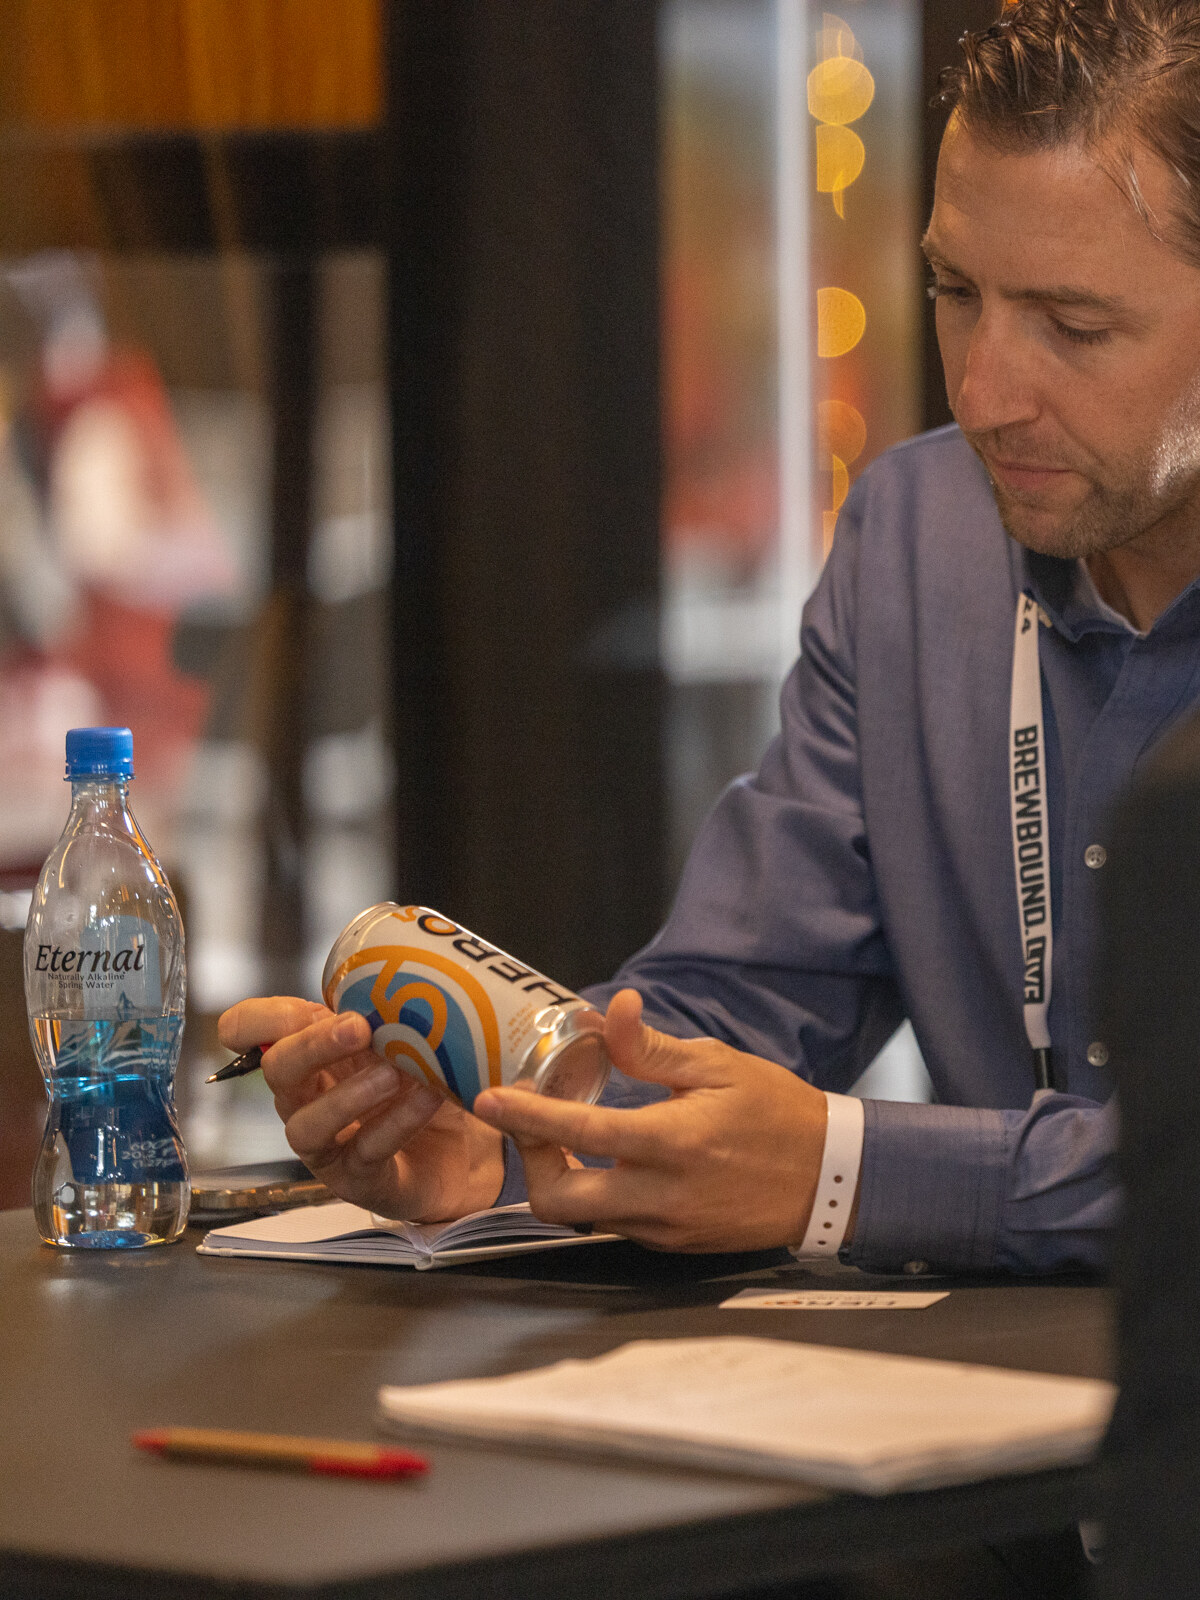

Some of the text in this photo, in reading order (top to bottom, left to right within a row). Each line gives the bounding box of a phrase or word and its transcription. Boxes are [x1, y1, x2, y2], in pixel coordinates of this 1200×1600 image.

[35, 943, 145, 973] Eternal
[47, 972, 85, 982] Naturally
[58, 981, 115, 990] Spring Water
